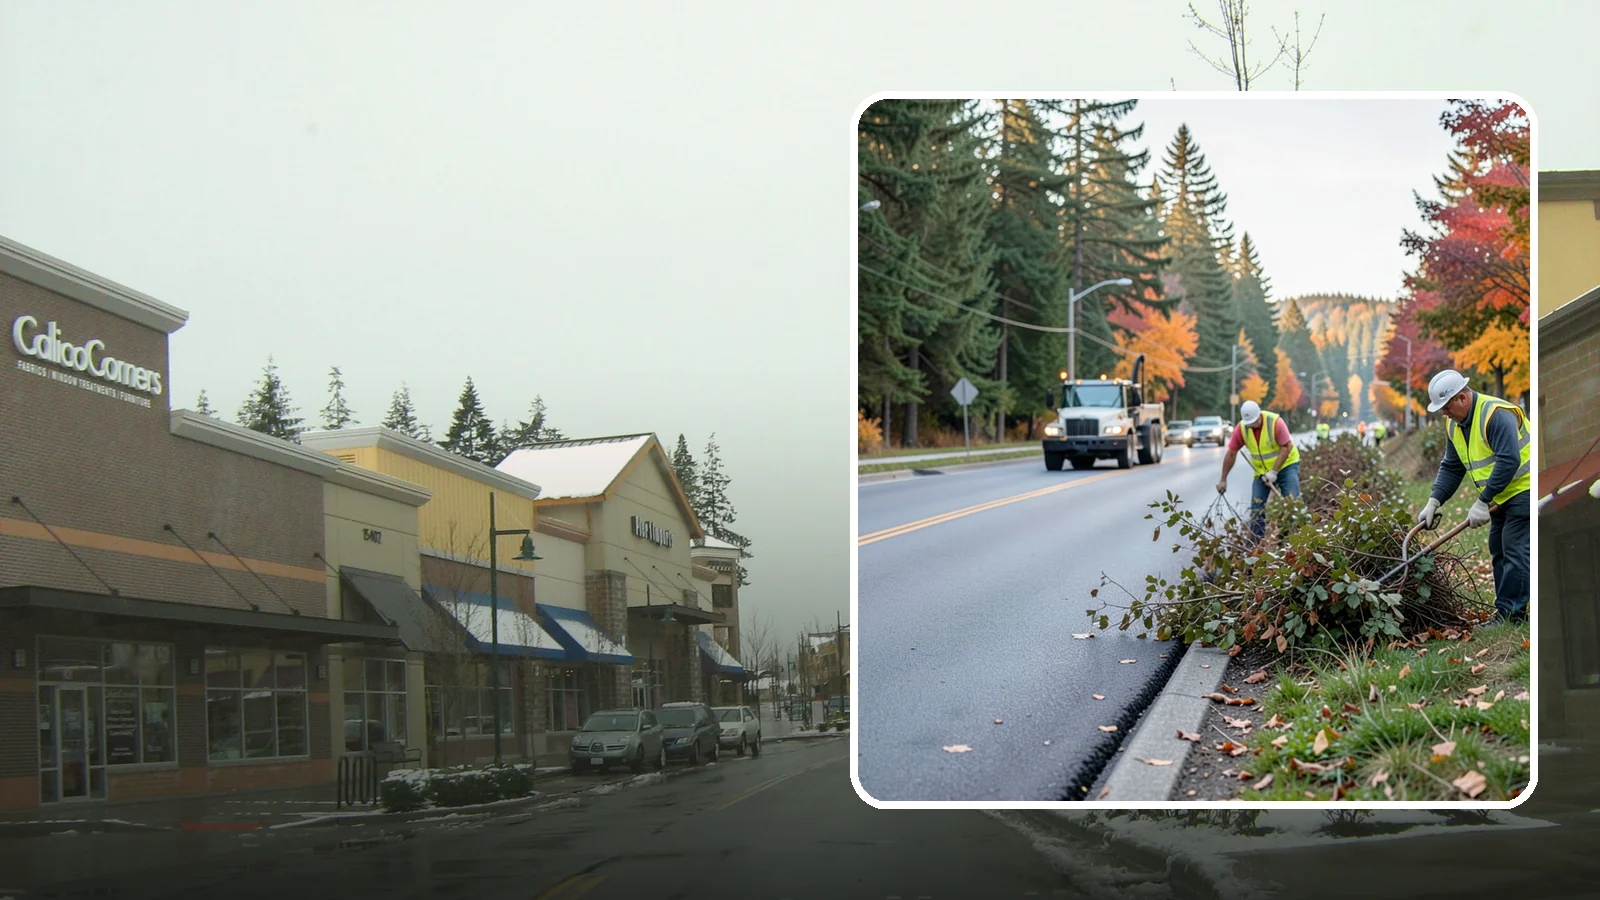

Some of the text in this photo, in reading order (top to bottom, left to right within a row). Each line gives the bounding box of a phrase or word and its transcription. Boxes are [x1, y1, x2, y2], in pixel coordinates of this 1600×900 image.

[17, 360, 151, 409] FABRICS WINDOW TREATMENTS FURNITURE
